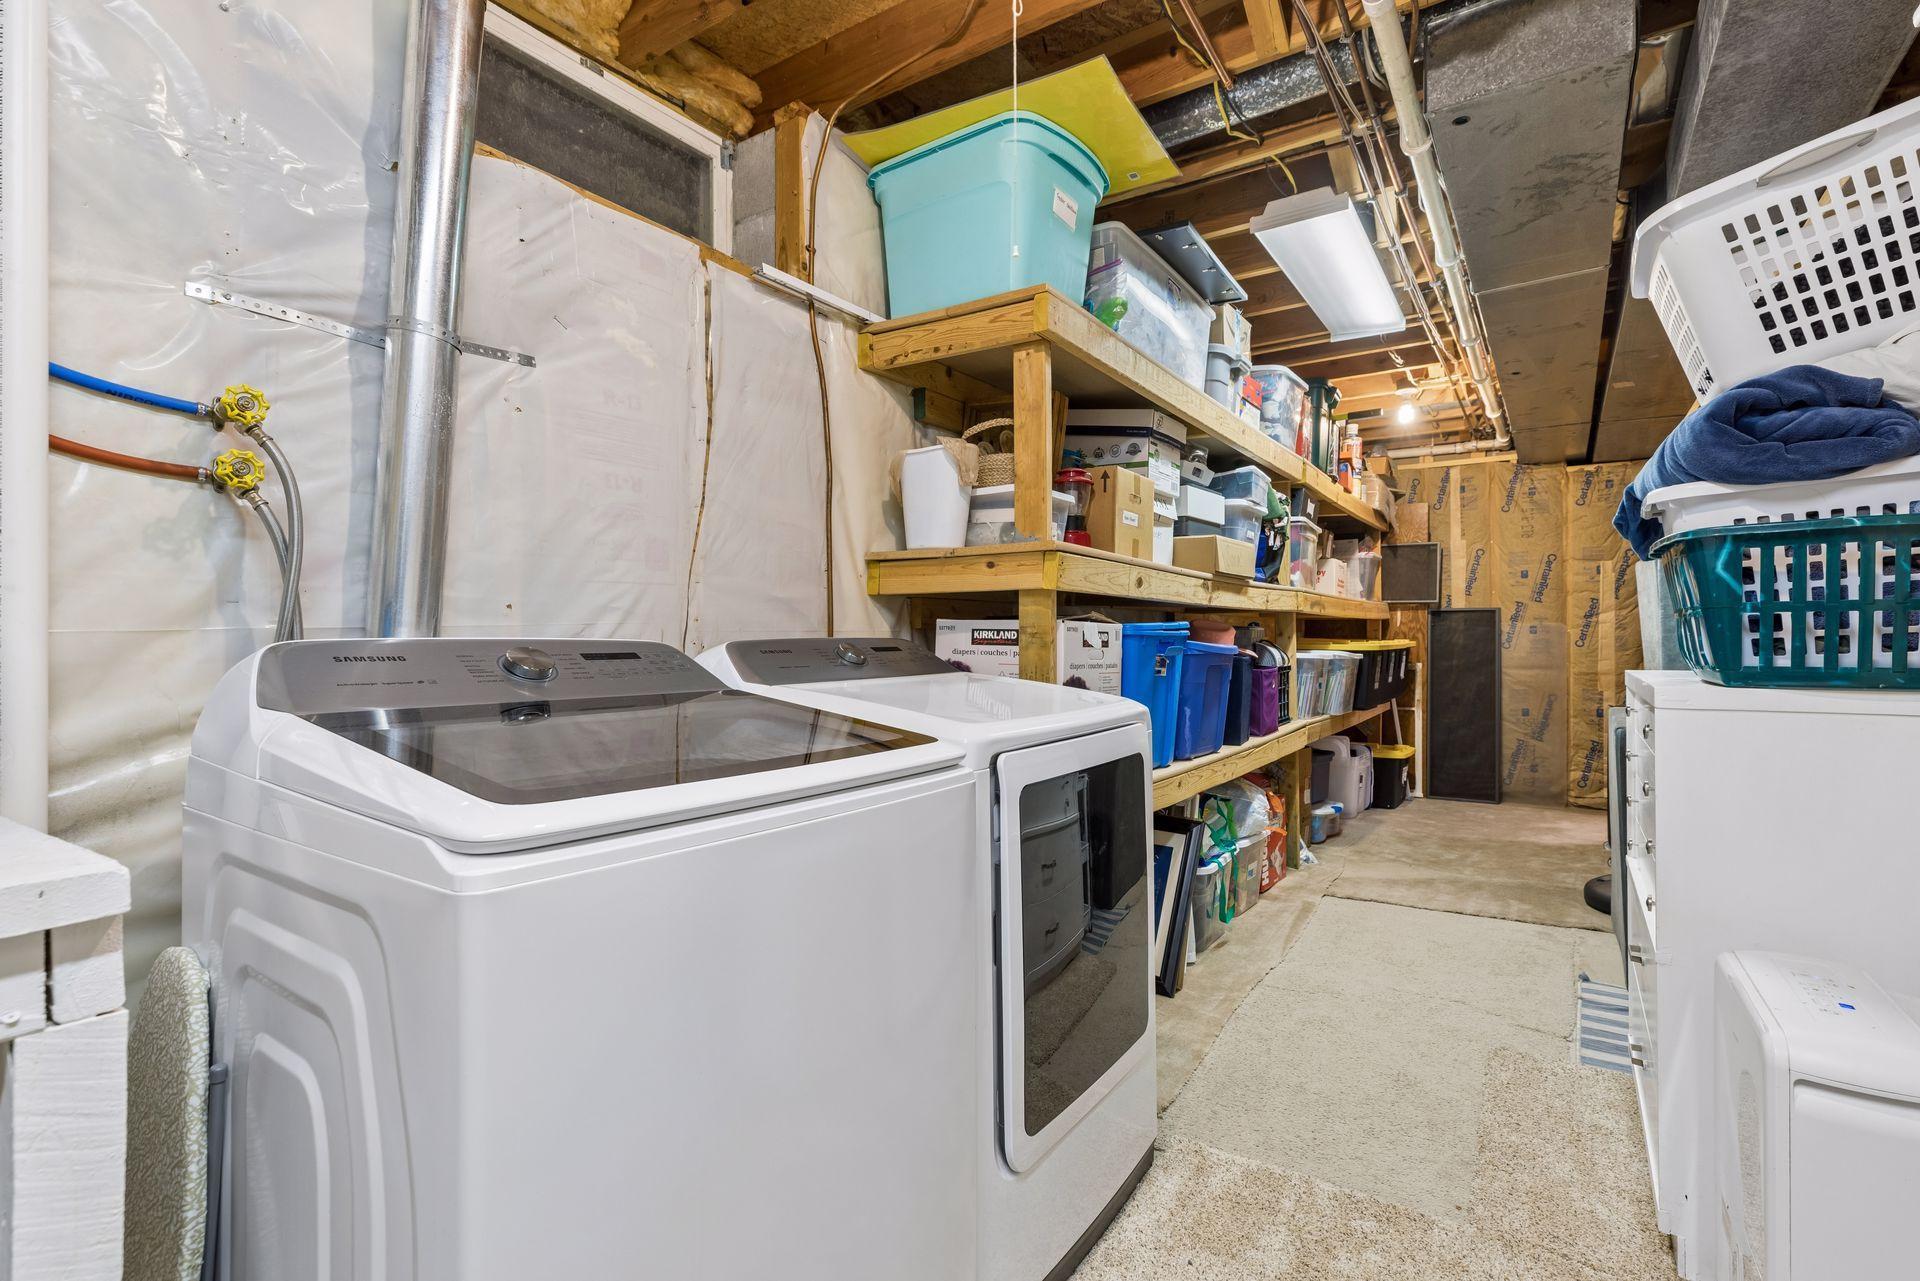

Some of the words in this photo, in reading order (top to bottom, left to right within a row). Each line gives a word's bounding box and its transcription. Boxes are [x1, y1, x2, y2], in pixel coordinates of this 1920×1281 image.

[1534, 553, 1557, 603] CertainTeed
[973, 630, 1017, 639] KIRKLAND
[1502, 601, 1524, 649] CertainTeed
[1575, 598, 1599, 647] CertainTeed
[332, 655, 407, 663] SAMSUNG
[951, 648, 976, 657] diapers
[980, 648, 1008, 656] couches
[1577, 740, 1599, 788] CertainTeed
